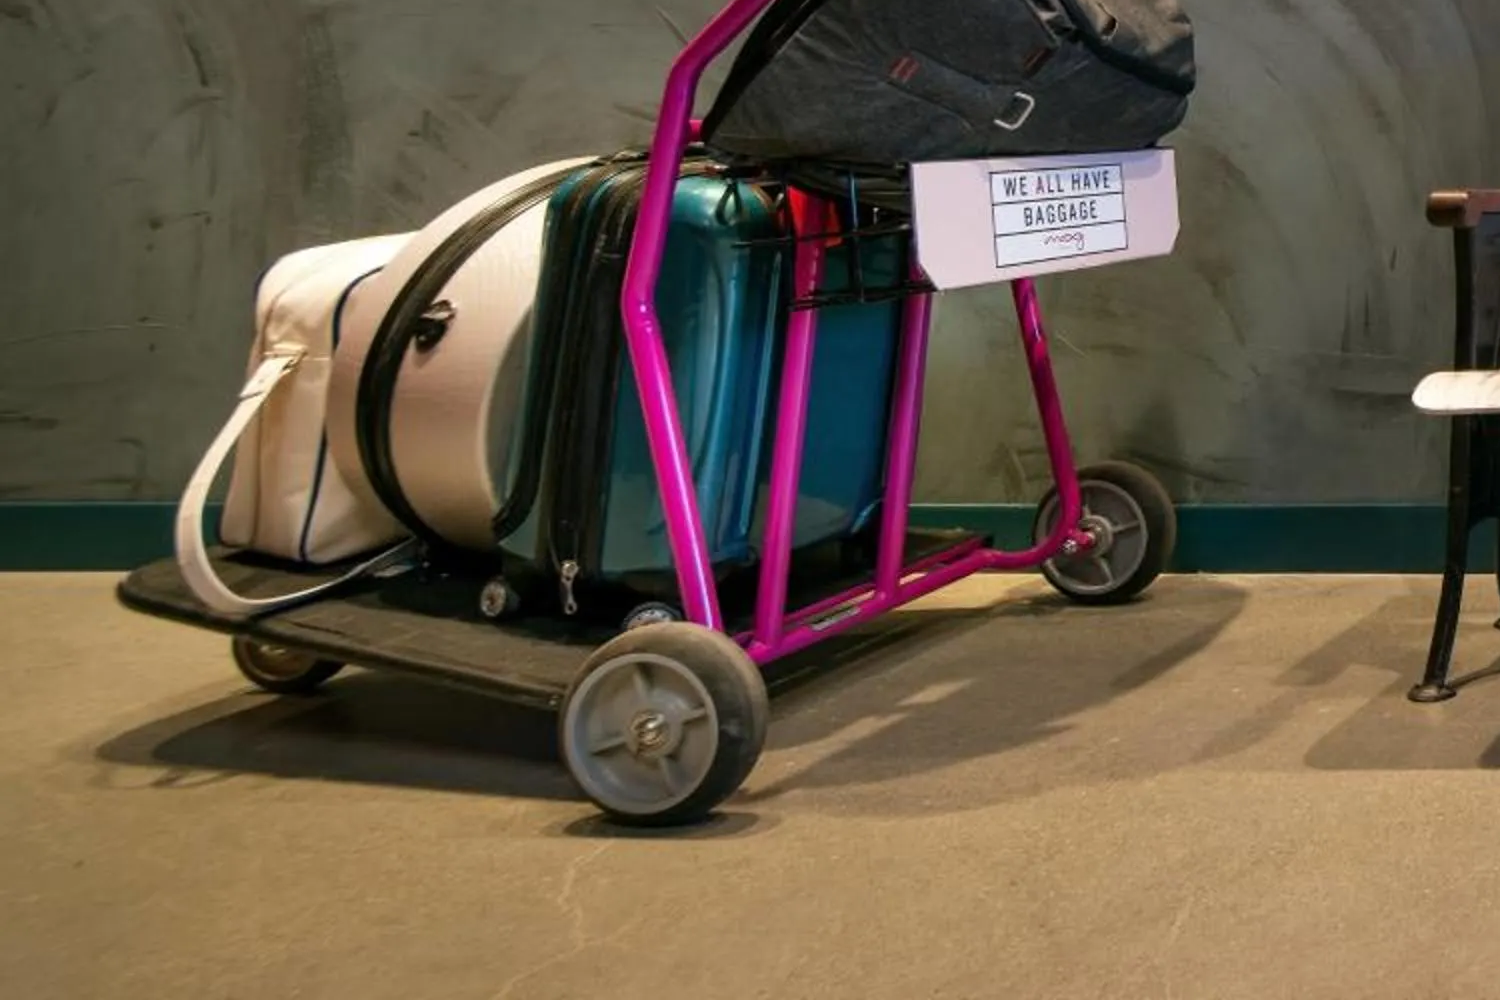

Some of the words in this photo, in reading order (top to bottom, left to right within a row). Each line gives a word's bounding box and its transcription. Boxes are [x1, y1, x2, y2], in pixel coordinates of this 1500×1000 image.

[1003, 175, 1028, 196] WE
[1035, 173, 1065, 195] ALL
[1071, 170, 1111, 191] HAVE
[1023, 200, 1098, 226] BAGGAGE
